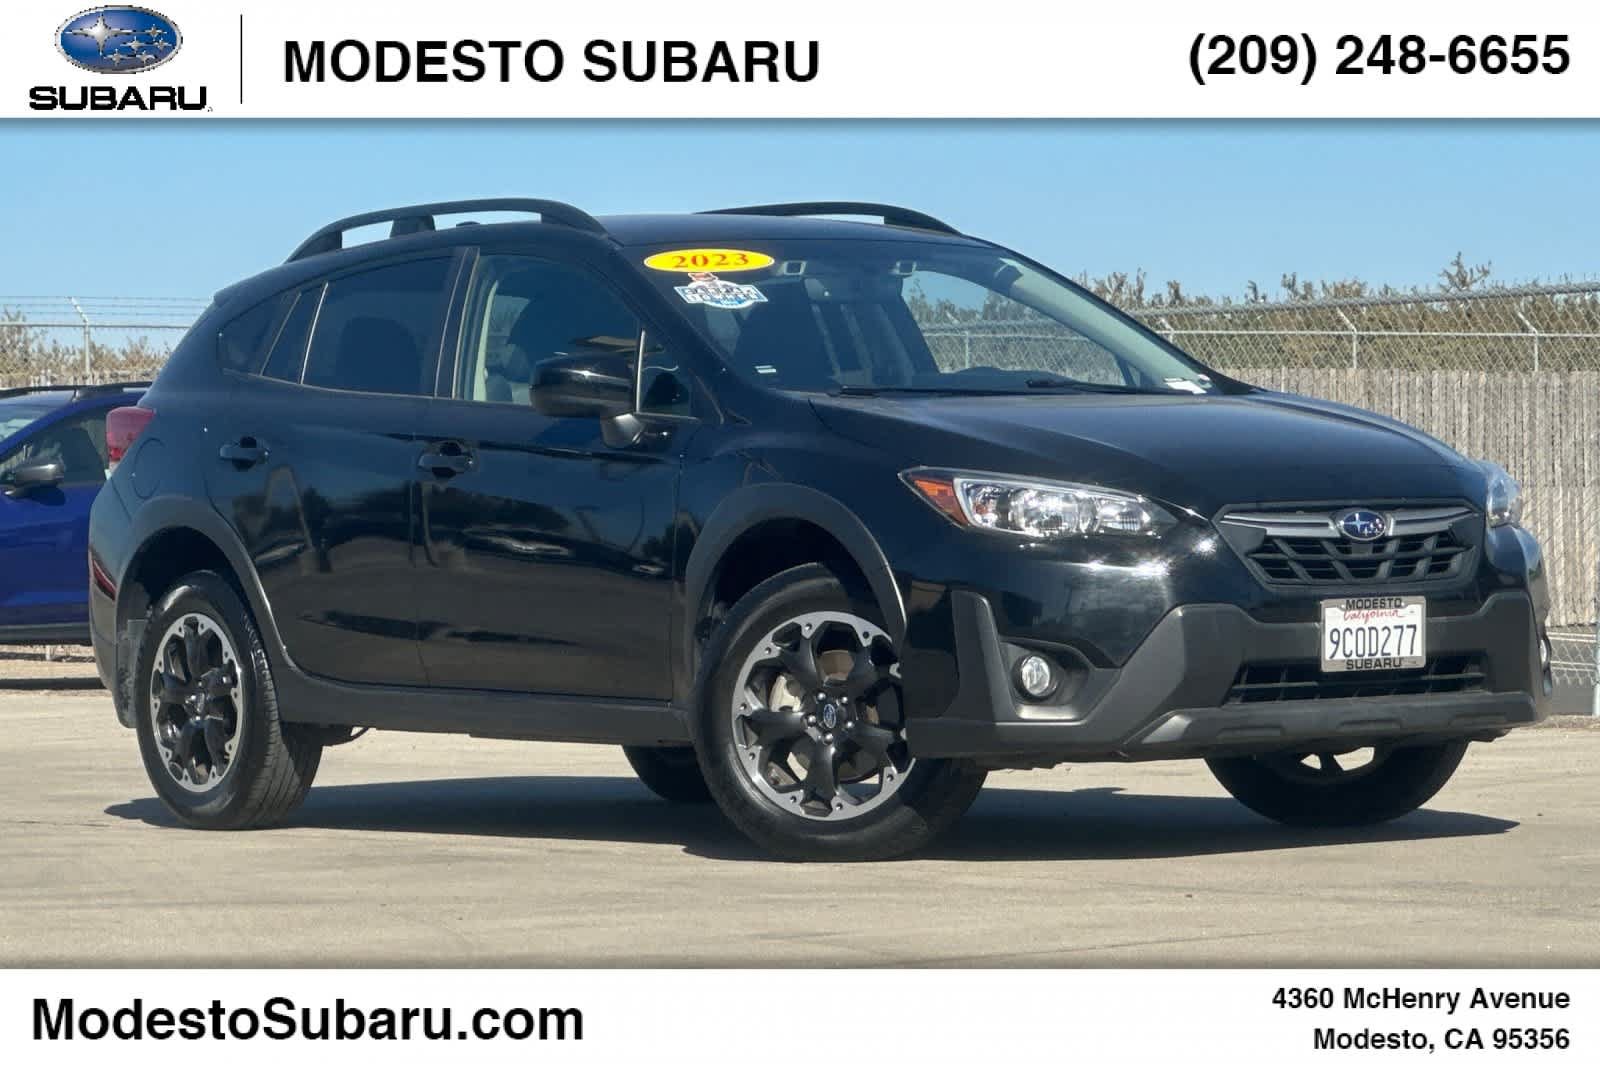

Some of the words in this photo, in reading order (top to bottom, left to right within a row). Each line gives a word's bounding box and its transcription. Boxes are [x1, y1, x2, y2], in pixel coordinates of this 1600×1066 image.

[671, 253, 749, 268] 2023
[1345, 598, 1402, 610] MODESTO
[1344, 609, 1405, 624] California
[1345, 658, 1403, 670] SUBARU
